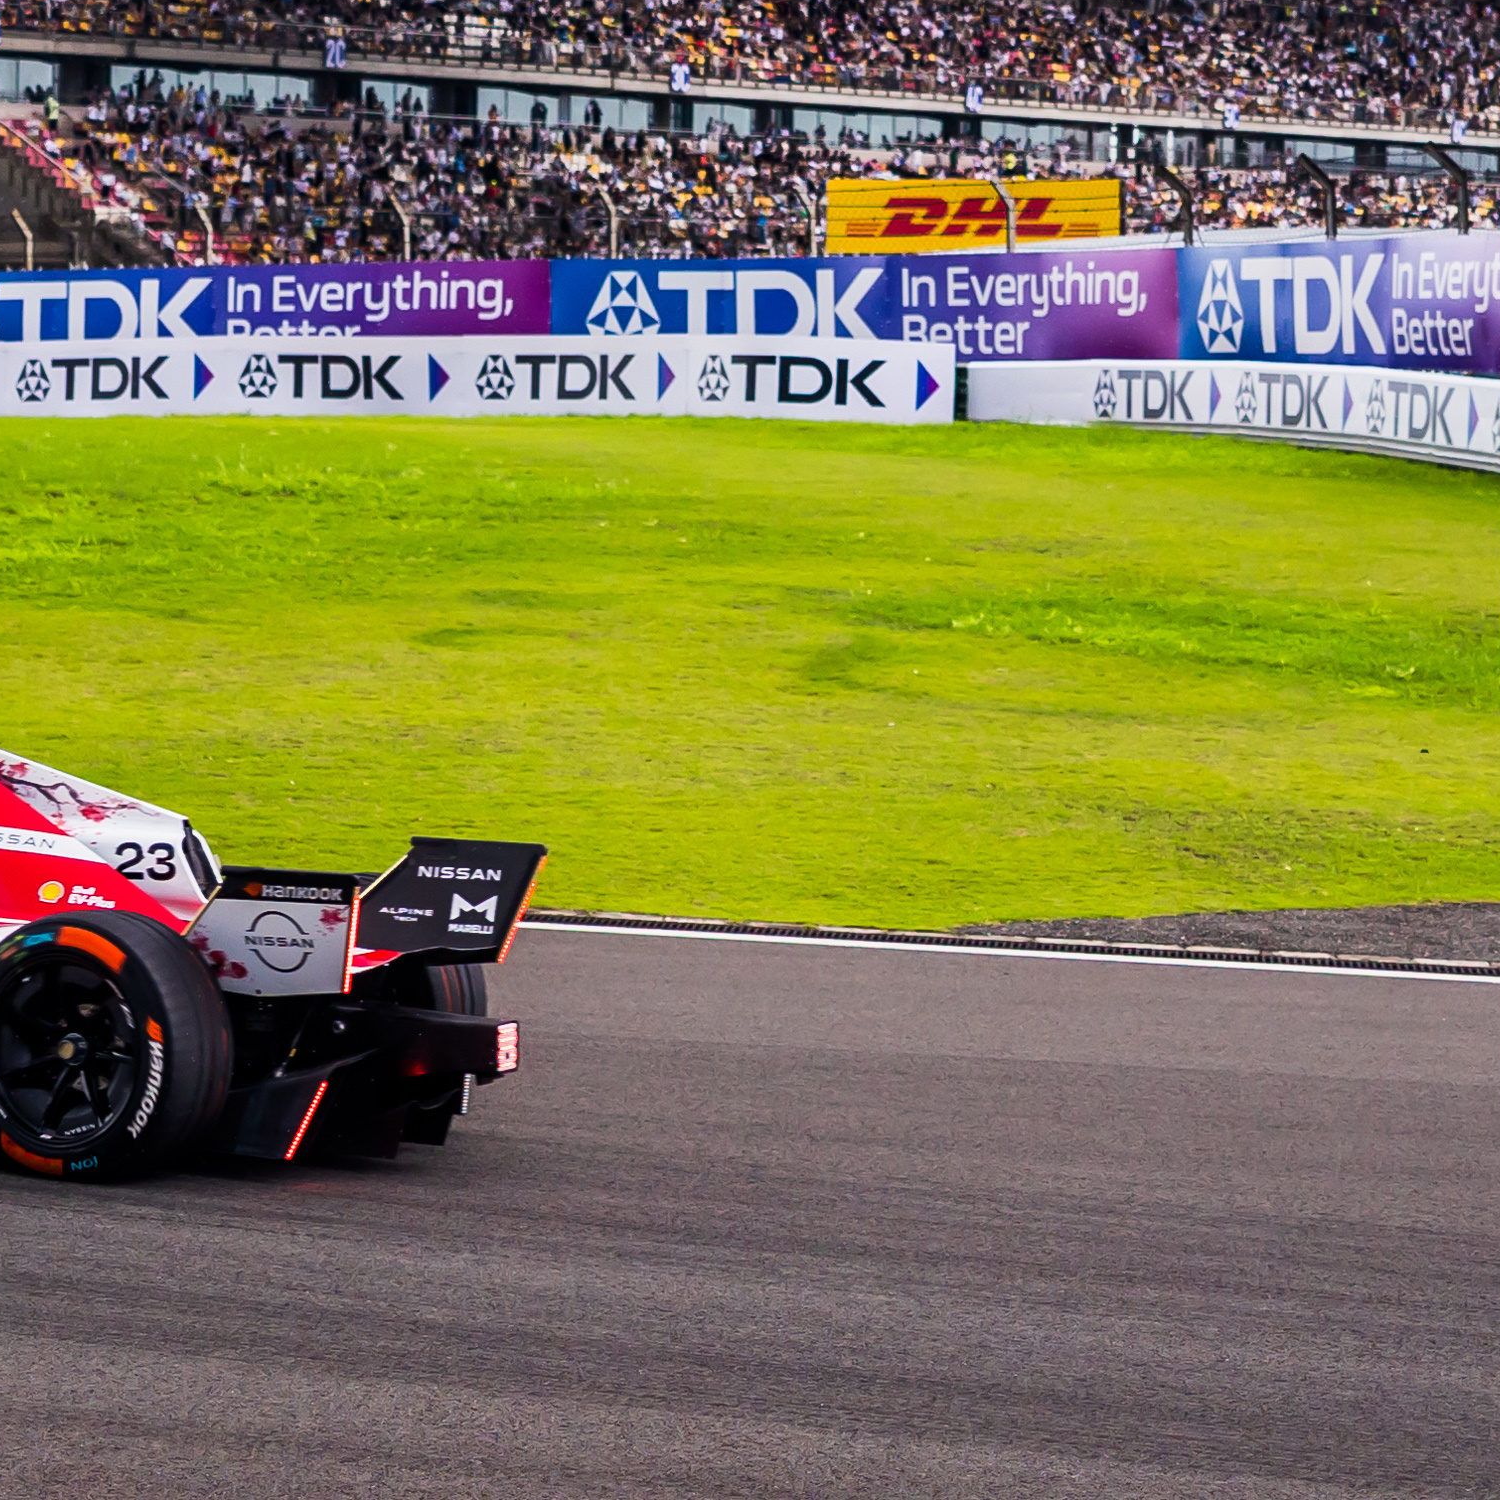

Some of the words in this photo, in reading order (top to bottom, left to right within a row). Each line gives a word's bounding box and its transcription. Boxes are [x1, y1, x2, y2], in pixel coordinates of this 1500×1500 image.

[882, 198, 1063, 237] DHL
[227, 276, 261, 313] In
[273, 270, 514, 322] Everything,
[902, 268, 936, 307] In
[947, 261, 1148, 317] Everything,
[1391, 253, 1416, 299] In
[658, 267, 884, 338] TDK
[1240, 253, 1387, 355] TDK
[902, 315, 1030, 355] Better
[1391, 307, 1474, 356] Better
[51, 356, 170, 401] TDK
[278, 354, 404, 400] TDK
[515, 354, 636, 401] TDK
[731, 355, 887, 407] TDK
[1117, 369, 1194, 422] TDK
[1258, 374, 1329, 430] TDK
[1387, 381, 1456, 447] TDK
[115, 841, 176, 882] 23
[417, 866, 502, 882] NISSAN
[378, 906, 435, 917] ALPINE
[447, 923, 495, 935] MARELLI
[244, 935, 315, 949] NISSAN
